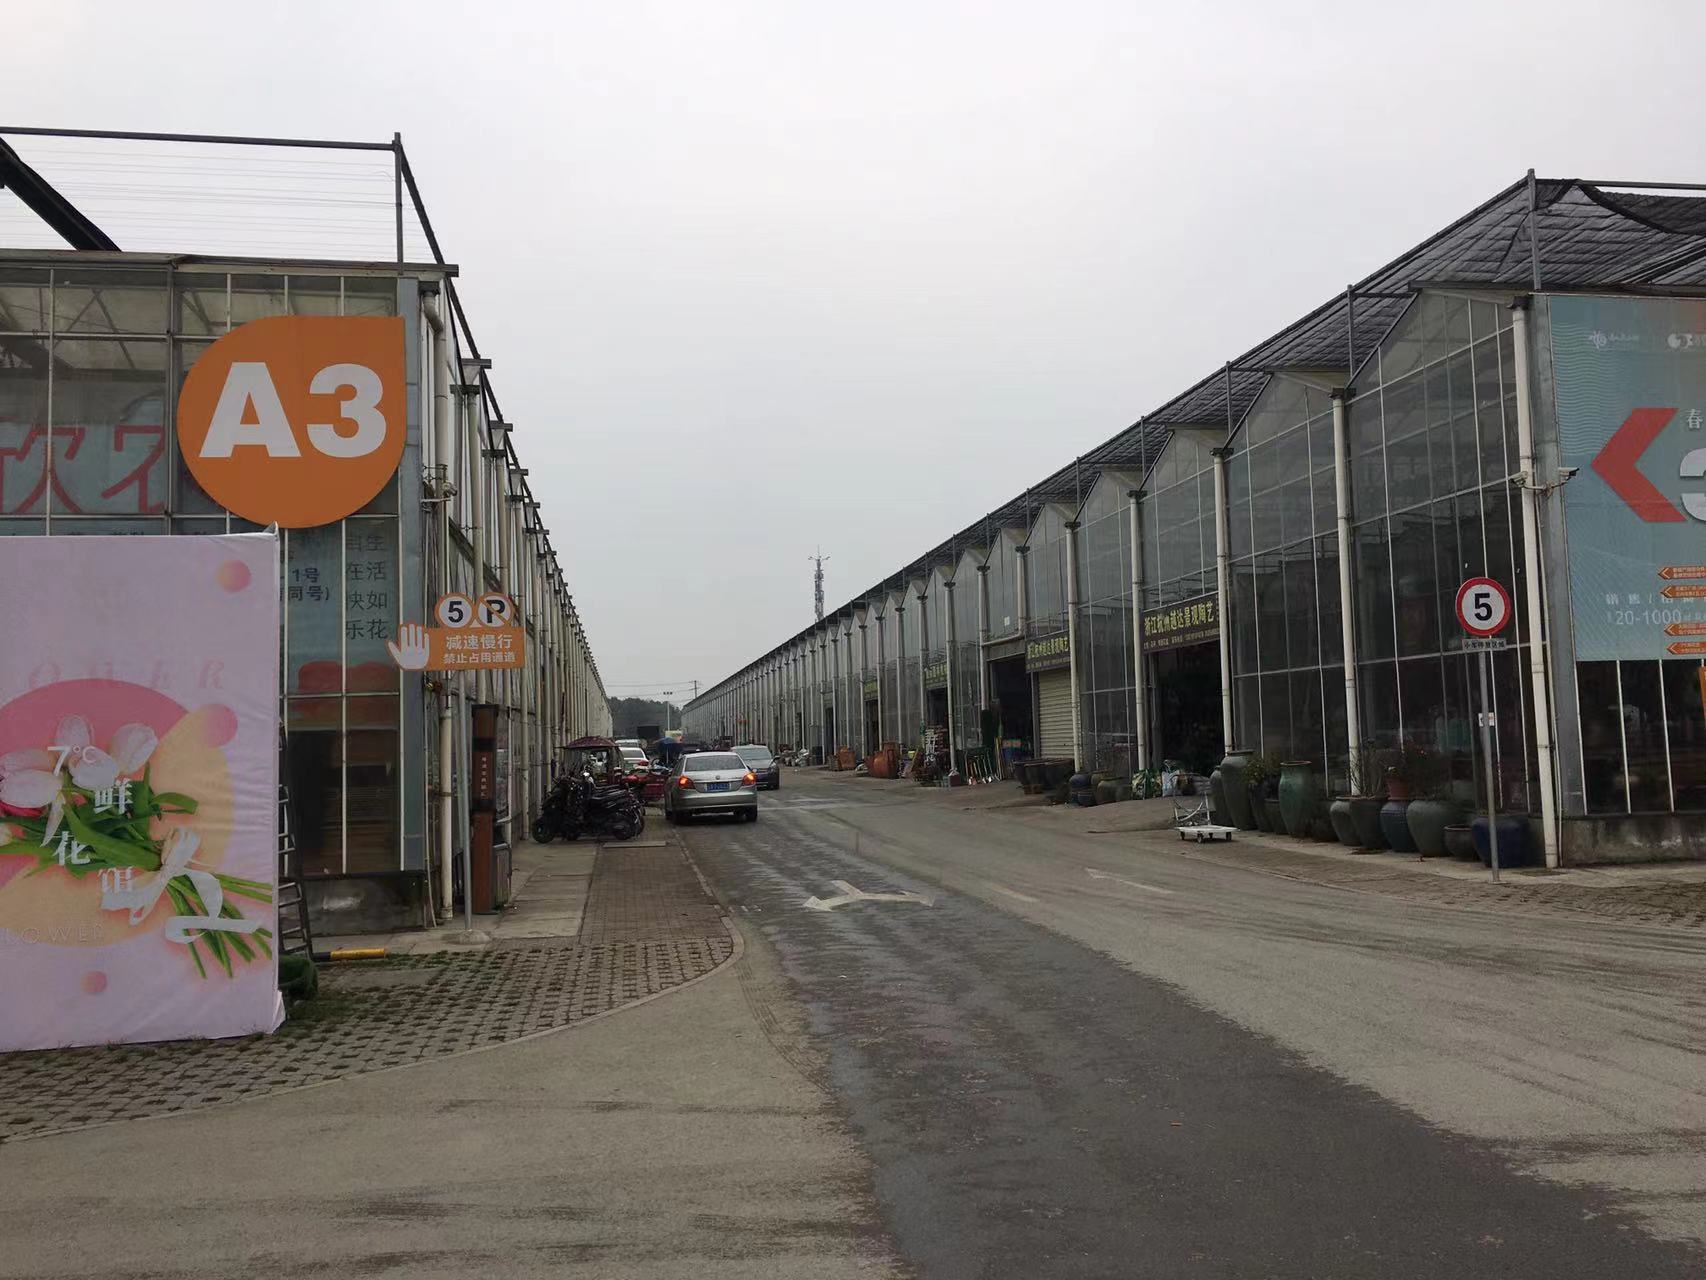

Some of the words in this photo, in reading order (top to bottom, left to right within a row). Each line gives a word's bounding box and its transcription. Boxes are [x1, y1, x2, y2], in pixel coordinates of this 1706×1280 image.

[199, 361, 387, 458] A3
[448, 600, 464, 623] 5
[1474, 592, 1493, 621] 5
[446, 634, 513, 650] 减速慢行
[443, 652, 516, 664] 禁止占用通道
